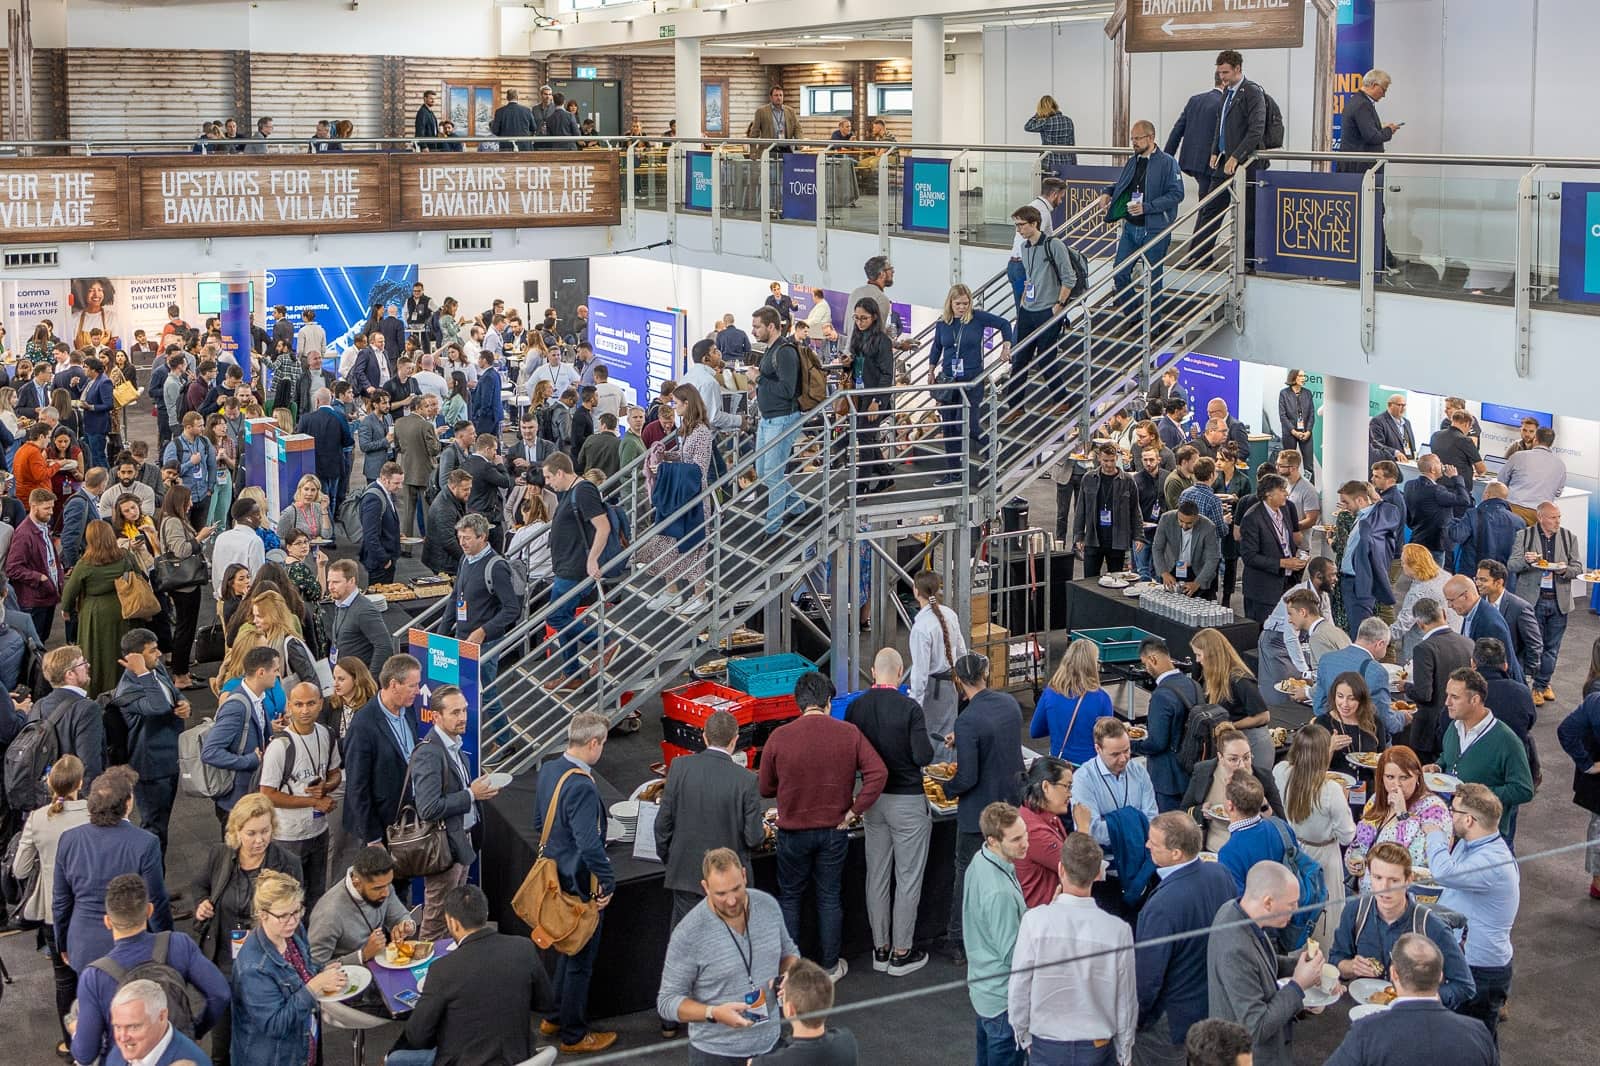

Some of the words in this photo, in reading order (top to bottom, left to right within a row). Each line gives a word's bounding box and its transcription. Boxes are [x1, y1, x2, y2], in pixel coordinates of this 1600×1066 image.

[50, 173, 95, 199] THE
[161, 170, 260, 197] UPSTAIRS
[270, 169, 311, 195] FOR
[321, 168, 361, 193] THE
[419, 167, 506, 191] UPSTAIRS
[515, 166, 551, 189] FOR
[560, 165, 596, 189] THE
[915, 182, 931, 192] OPEN
[421, 191, 511, 217] BAVARIAN
[519, 190, 595, 214] VILLAGE
[919, 190, 945, 200] BANKING
[919, 199, 935, 207] EXPO
[0, 200, 94, 228] VILLAGE
[164, 197, 264, 224] BAVARIAN
[276, 195, 360, 221] VILLAGE
[1284, 197, 1351, 217] BUSINESS
[1283, 210, 1350, 232] DESIGN
[1282, 229, 1350, 253] CENTRE
[18, 289, 50, 297] comma
[131, 284, 177, 293] PAYMENTS
[30, 301, 43, 309] PAY
[38, 308, 58, 316] STUFF
[131, 302, 165, 310] SHOULD
